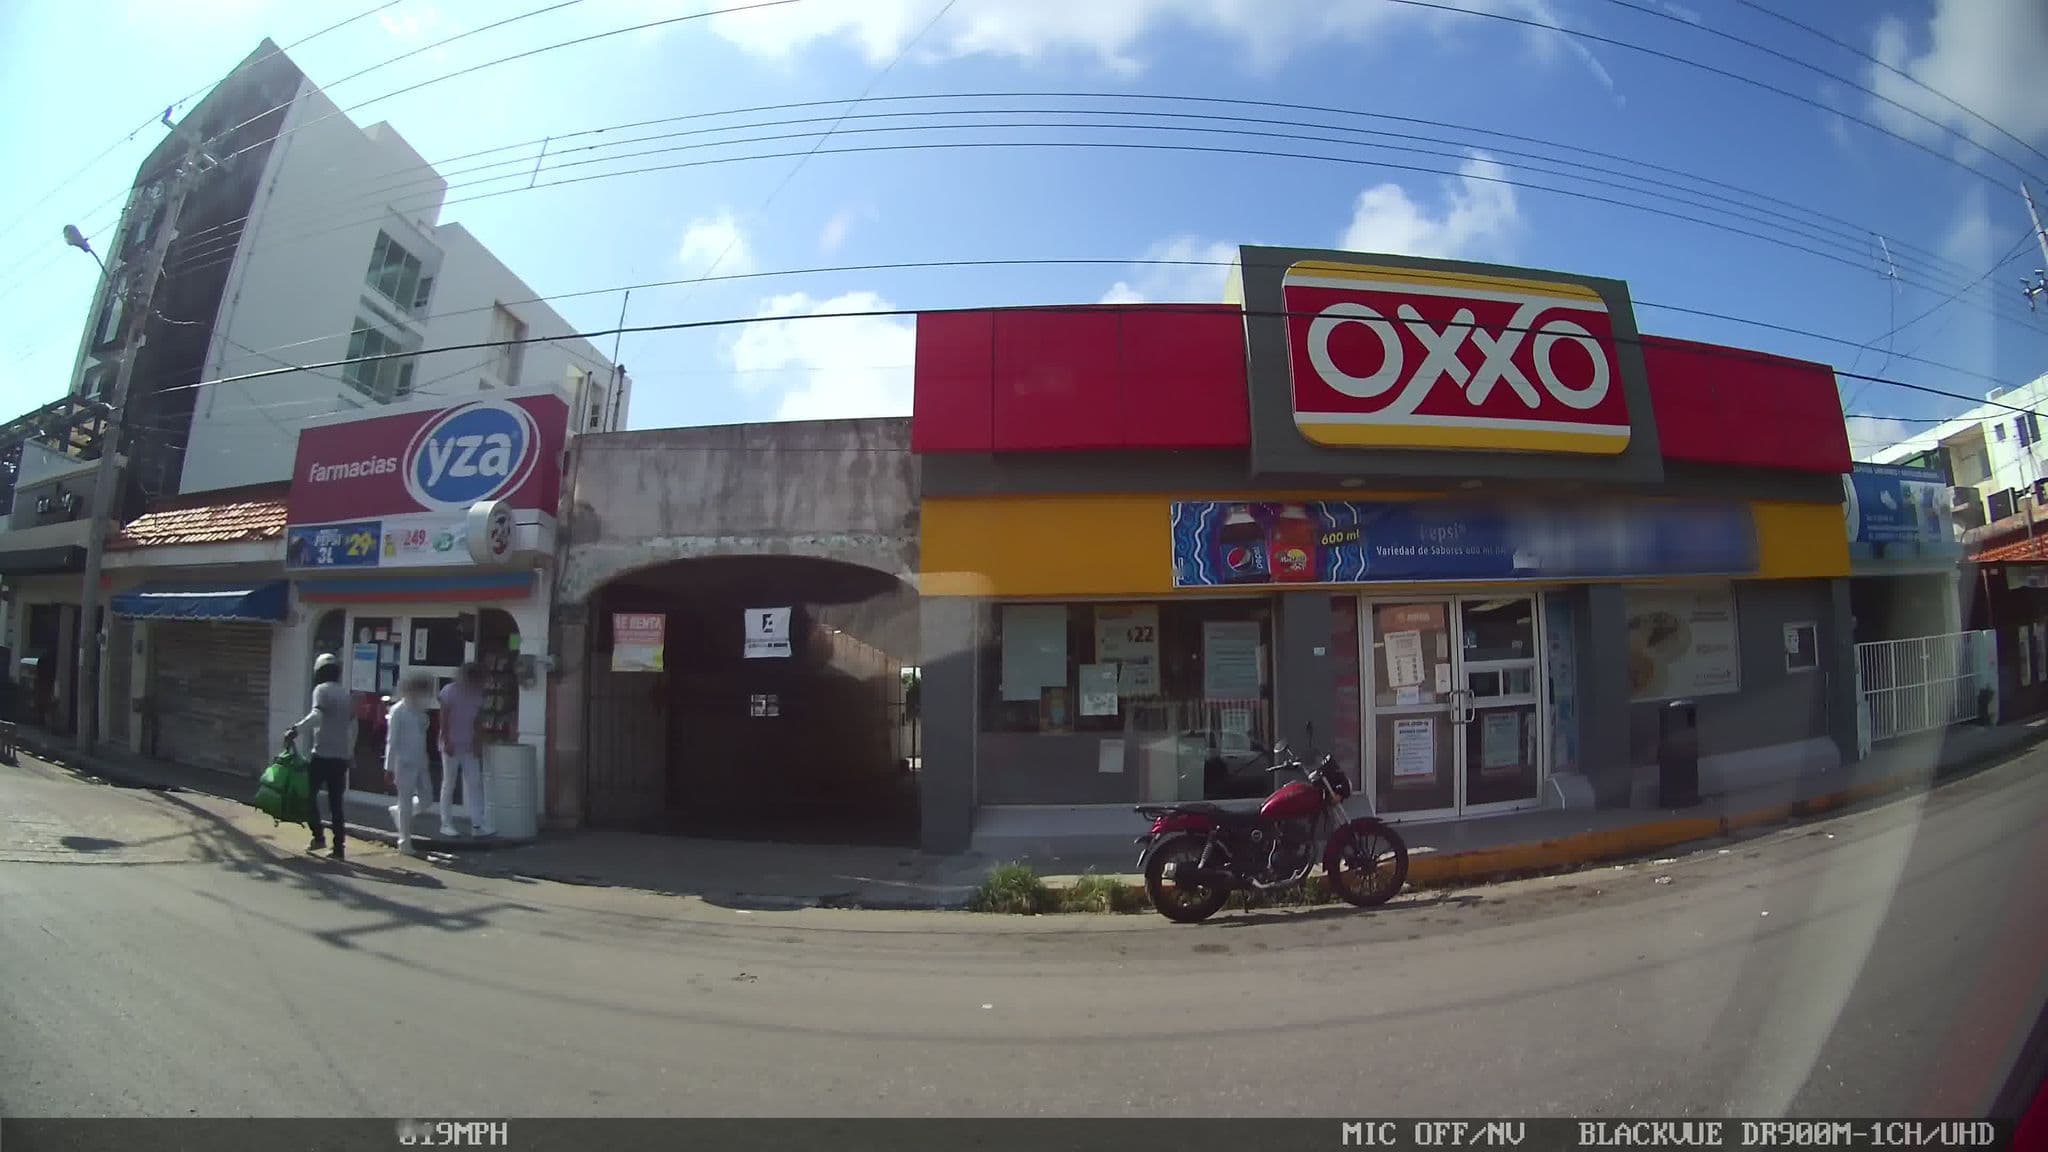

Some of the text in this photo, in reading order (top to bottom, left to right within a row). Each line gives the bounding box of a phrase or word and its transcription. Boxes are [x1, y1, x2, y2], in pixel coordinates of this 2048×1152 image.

[1307, 301, 1610, 411] OXXO
[428, 433, 512, 487] yza
[1321, 528, 1360, 545] 600 ml
[1376, 545, 1415, 556] Variedad
[1418, 545, 1429, 556] de
